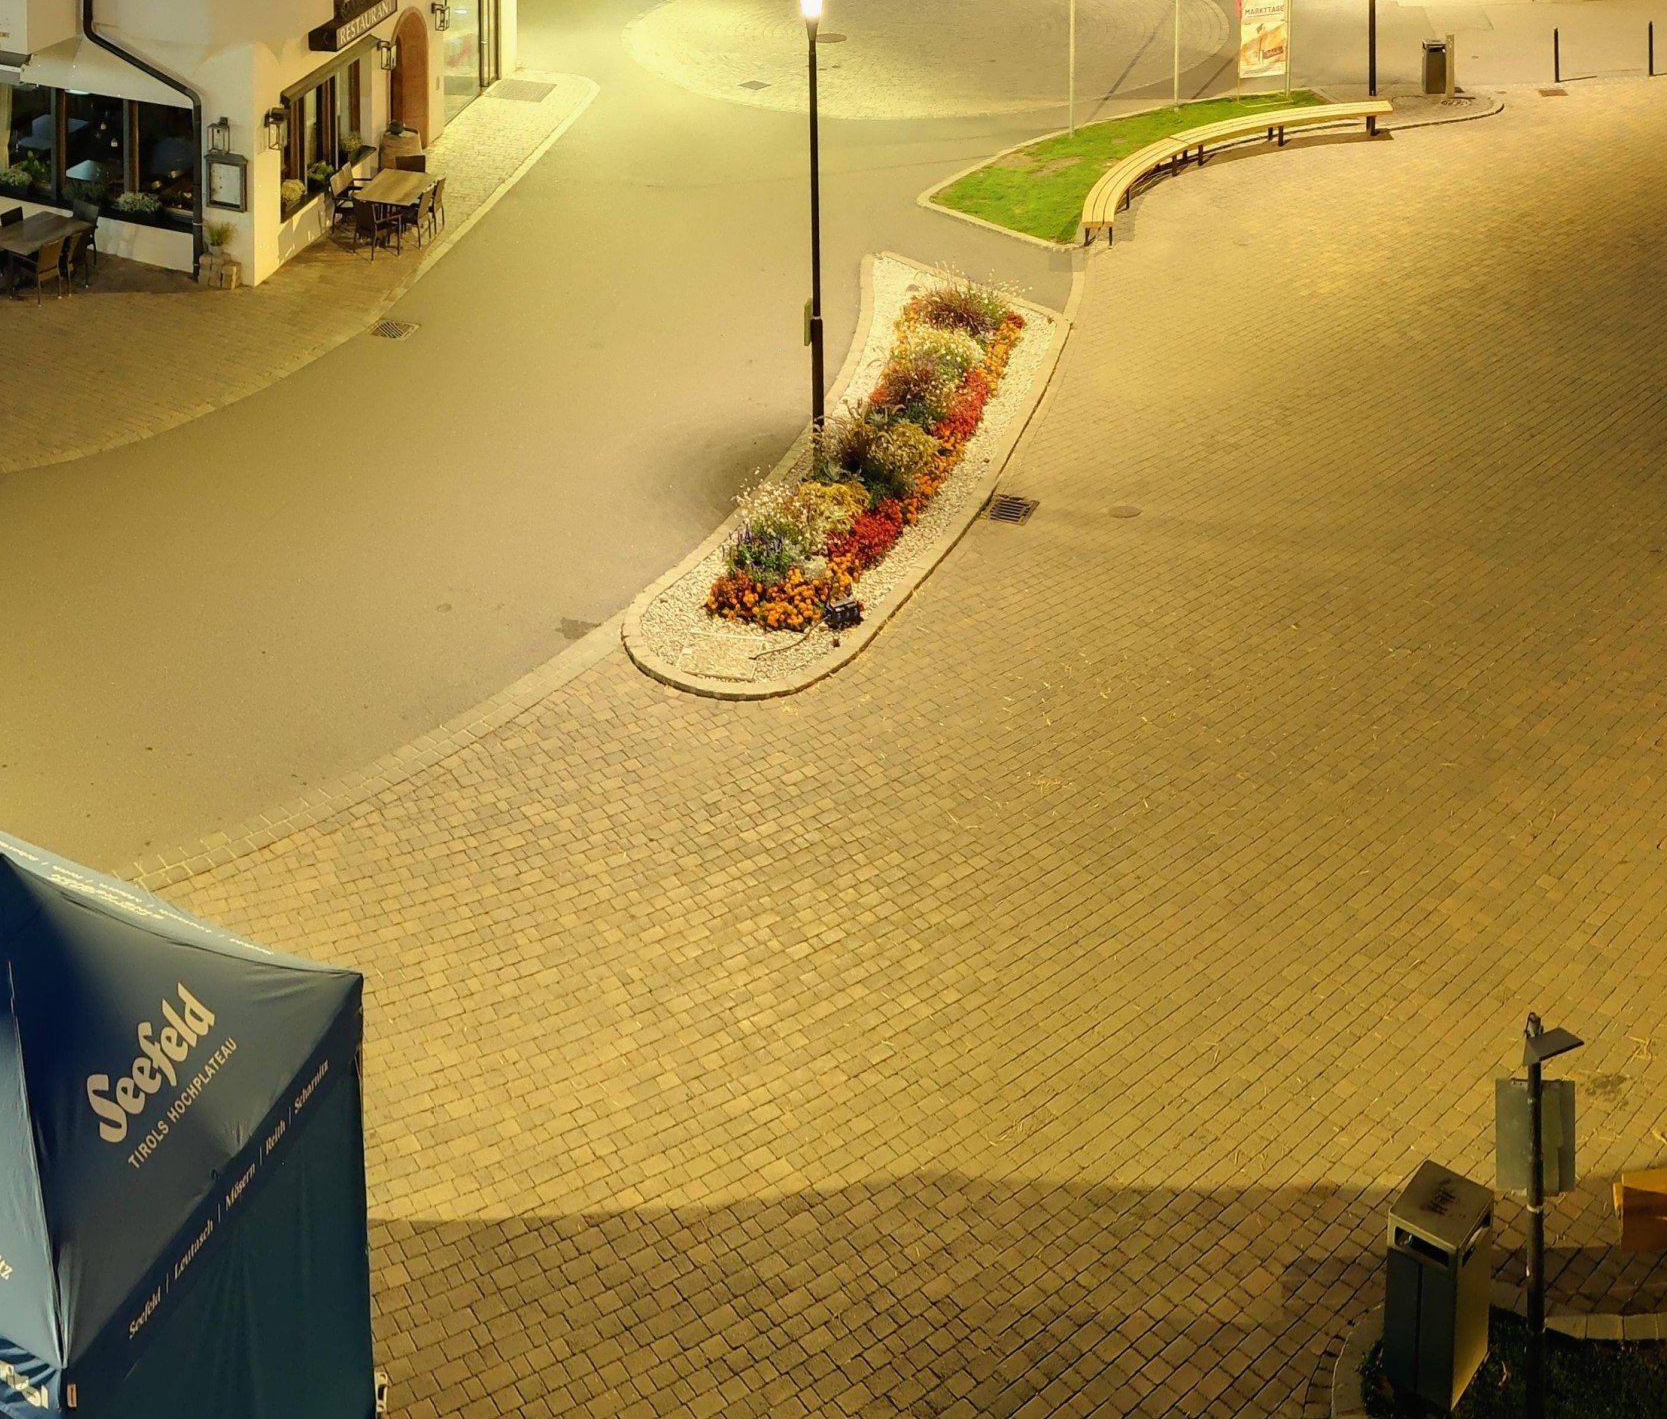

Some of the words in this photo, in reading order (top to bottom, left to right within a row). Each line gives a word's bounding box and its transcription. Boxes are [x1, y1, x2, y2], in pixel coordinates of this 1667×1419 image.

[1244, 4, 1285, 16] MARKTTAGE
[87, 981, 215, 1143] Seefeld
[127, 1119, 170, 1169] TIROLS
[166, 1036, 239, 1123] HOCHPLATEAU
[128, 1286, 162, 1339] Seefeld
[174, 1219, 213, 1280] Leutasch
[225, 1162, 256, 1211] Mösern
[265, 1120, 286, 1156] Reith
[294, 1059, 330, 1114] Scharnitz
